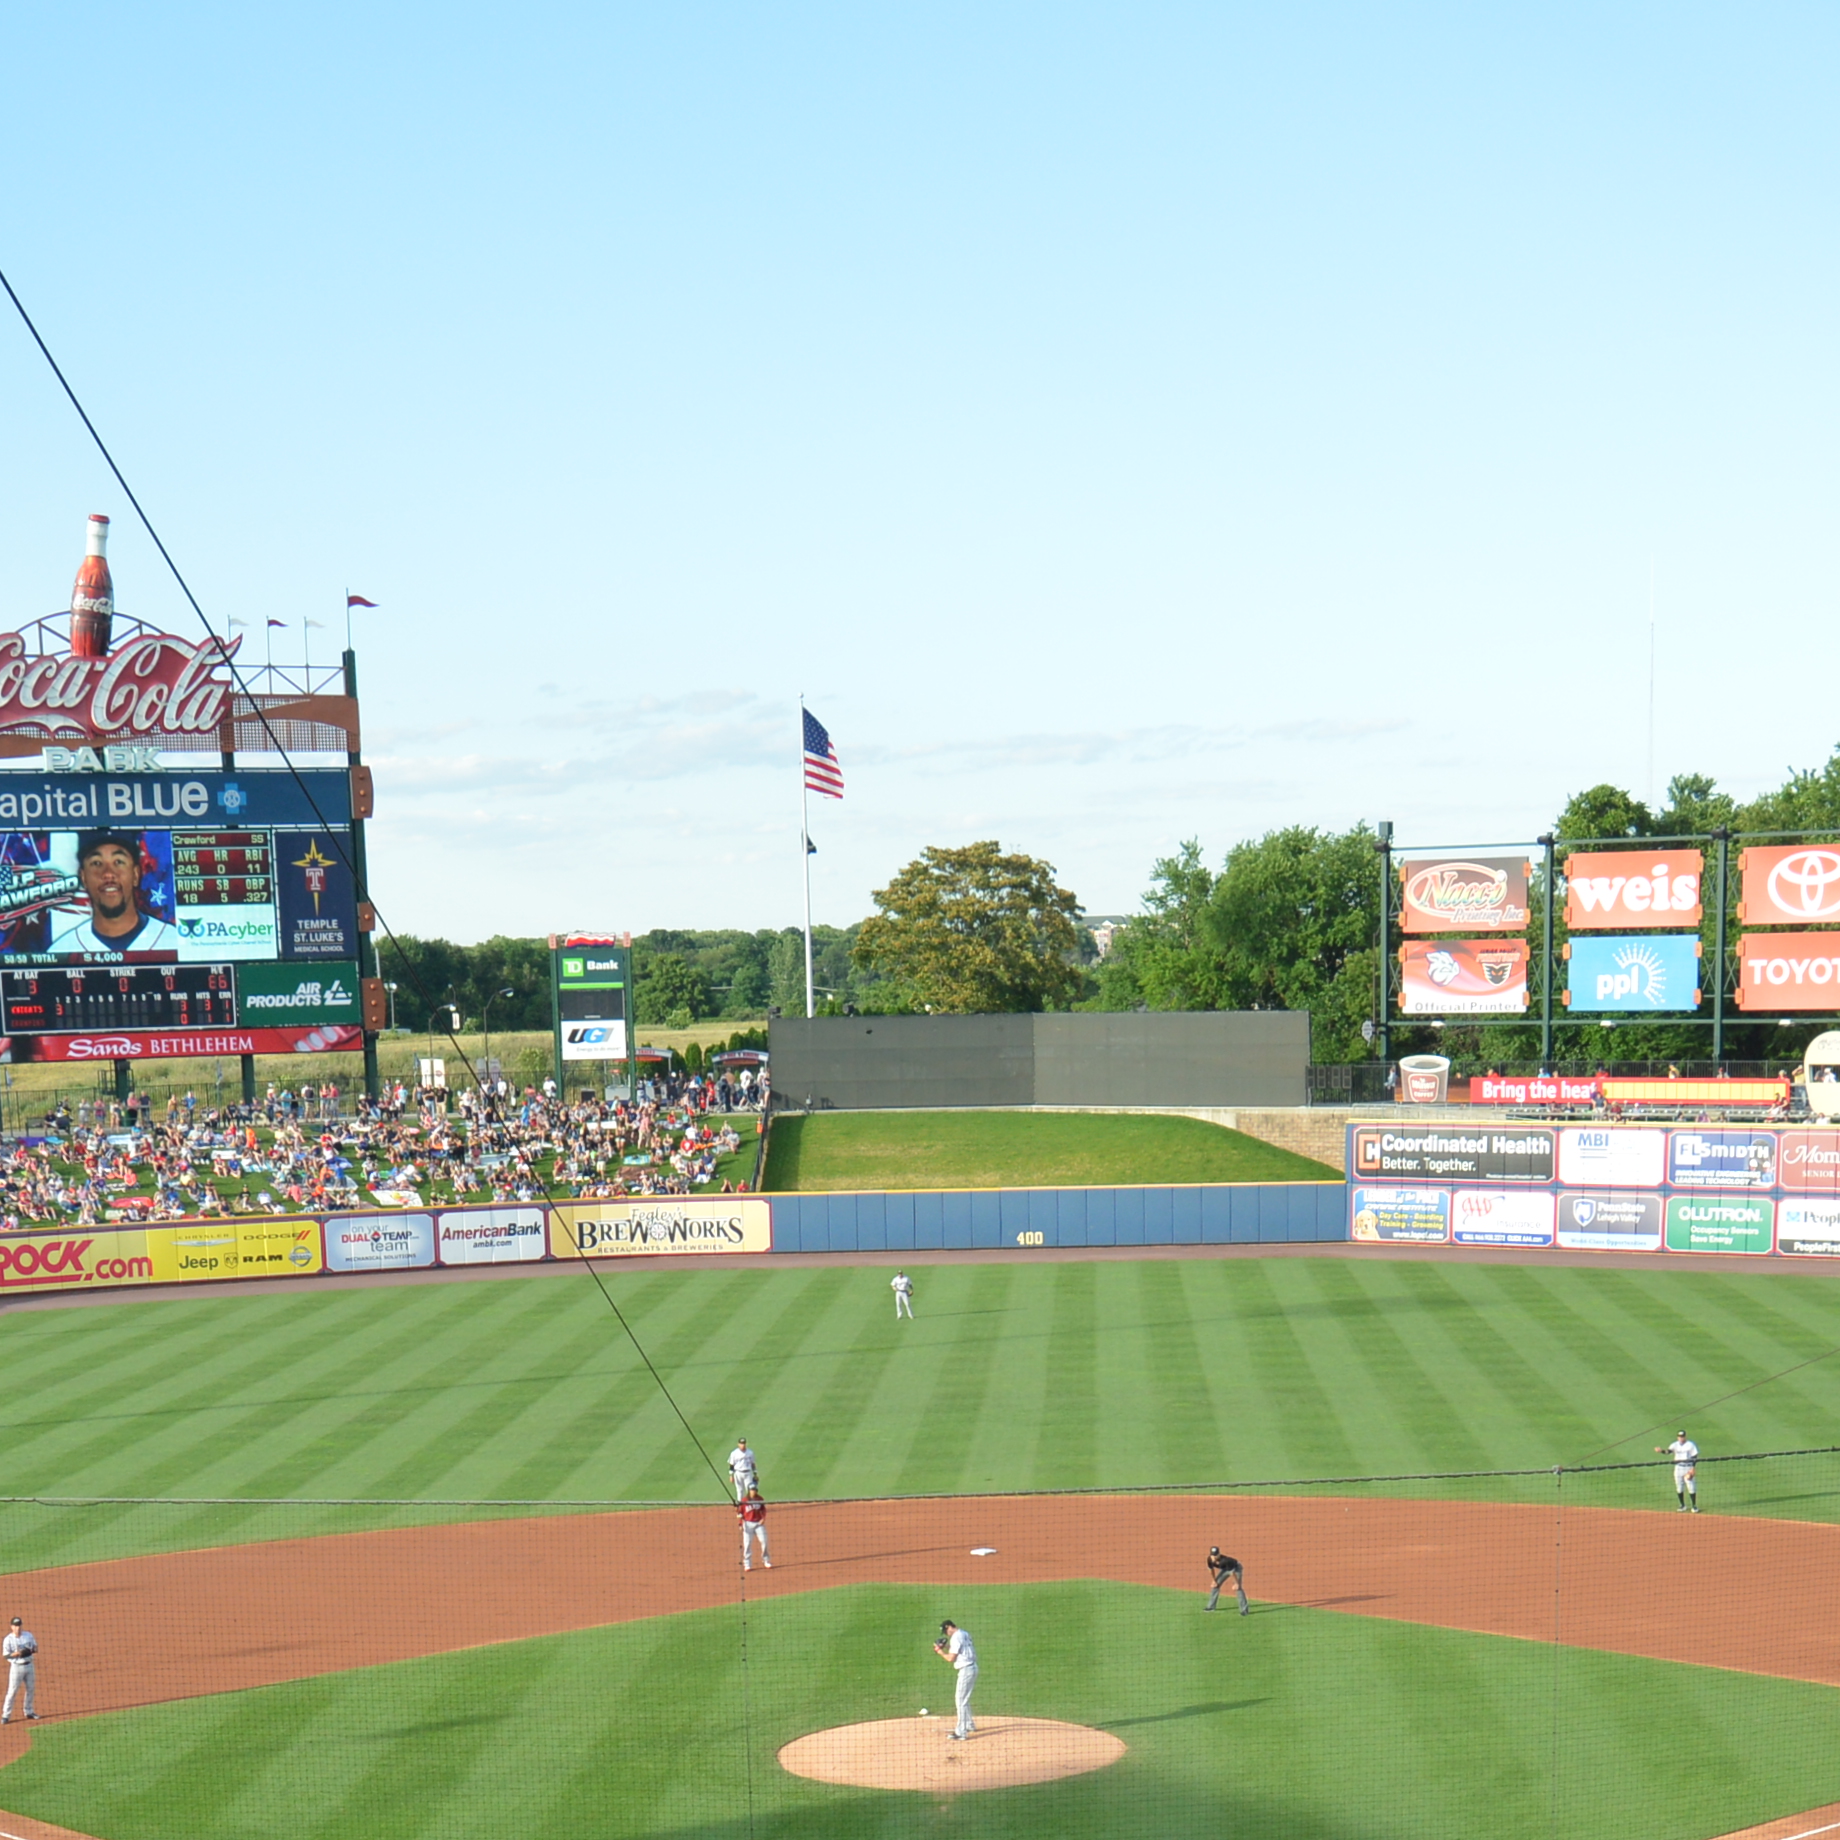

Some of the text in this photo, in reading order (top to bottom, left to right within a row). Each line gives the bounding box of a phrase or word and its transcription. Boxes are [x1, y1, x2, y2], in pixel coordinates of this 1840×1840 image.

[43, 746, 165, 773] PARK
[178, 849, 262, 862] AVG HR RBI
[177, 878, 265, 891] RUNS SB OBP
[1570, 864, 1696, 912] weis
[297, 919, 338, 931] TEMPLE
[296, 983, 321, 994] AIR
[246, 993, 321, 1008] PRODUCTS
[1415, 1001, 1517, 1012] Official Printer
[67, 1037, 254, 1058] Sands BETHLEHEM
[1381, 1133, 1550, 1155] Coordinated Health
[1578, 1133, 1608, 1147] MBI
[1382, 1156, 1476, 1173] Better. Together.
[1802, 1169, 1835, 1179] SENIOR
[1597, 1213, 1641, 1224] Lehigh Valley
[473, 1239, 513, 1249] ambk.com
[1016, 1231, 1044, 1246] 400
[370, 1240, 409, 1252] team
[179, 1253, 219, 1272] Jeep
[243, 1254, 283, 1264] RAM
